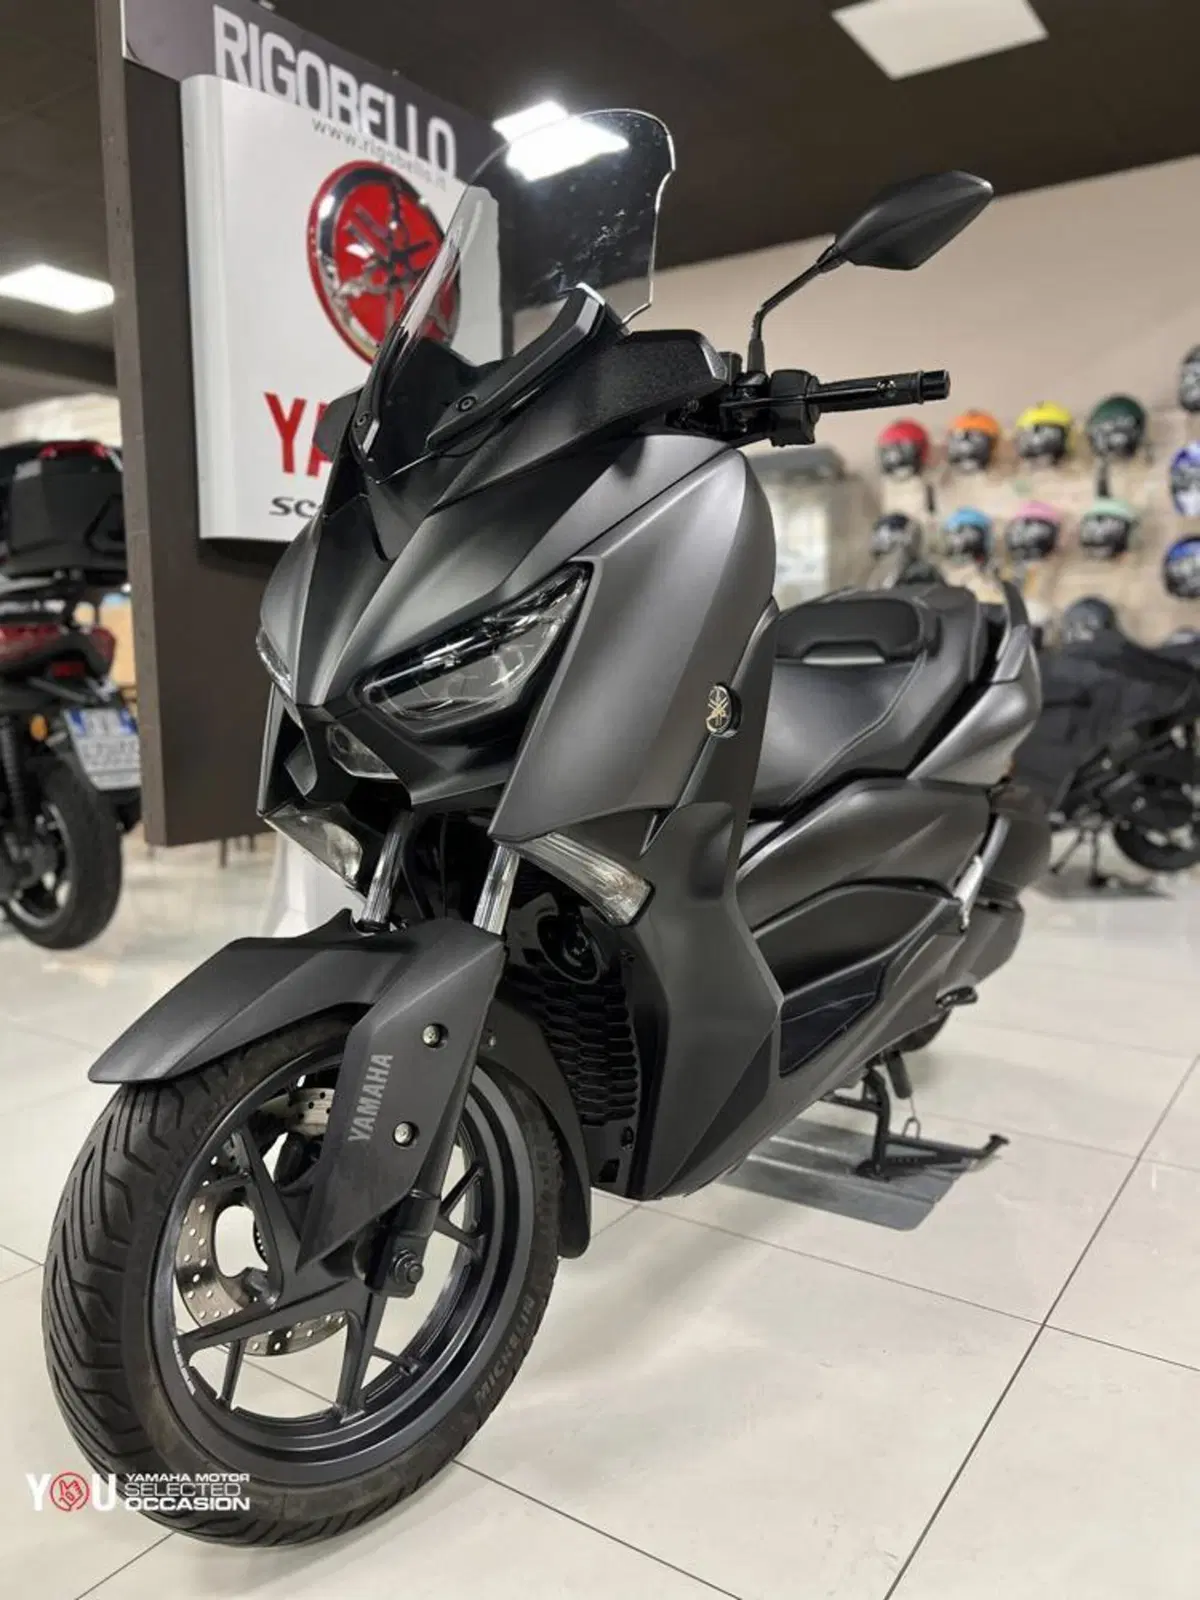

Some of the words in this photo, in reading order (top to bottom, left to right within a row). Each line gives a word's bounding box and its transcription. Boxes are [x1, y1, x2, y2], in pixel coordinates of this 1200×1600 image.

[212, 4, 457, 178] RIGOBELLO
[268, 496, 322, 518] SC
[347, 1054, 394, 1141] YAMAHA
